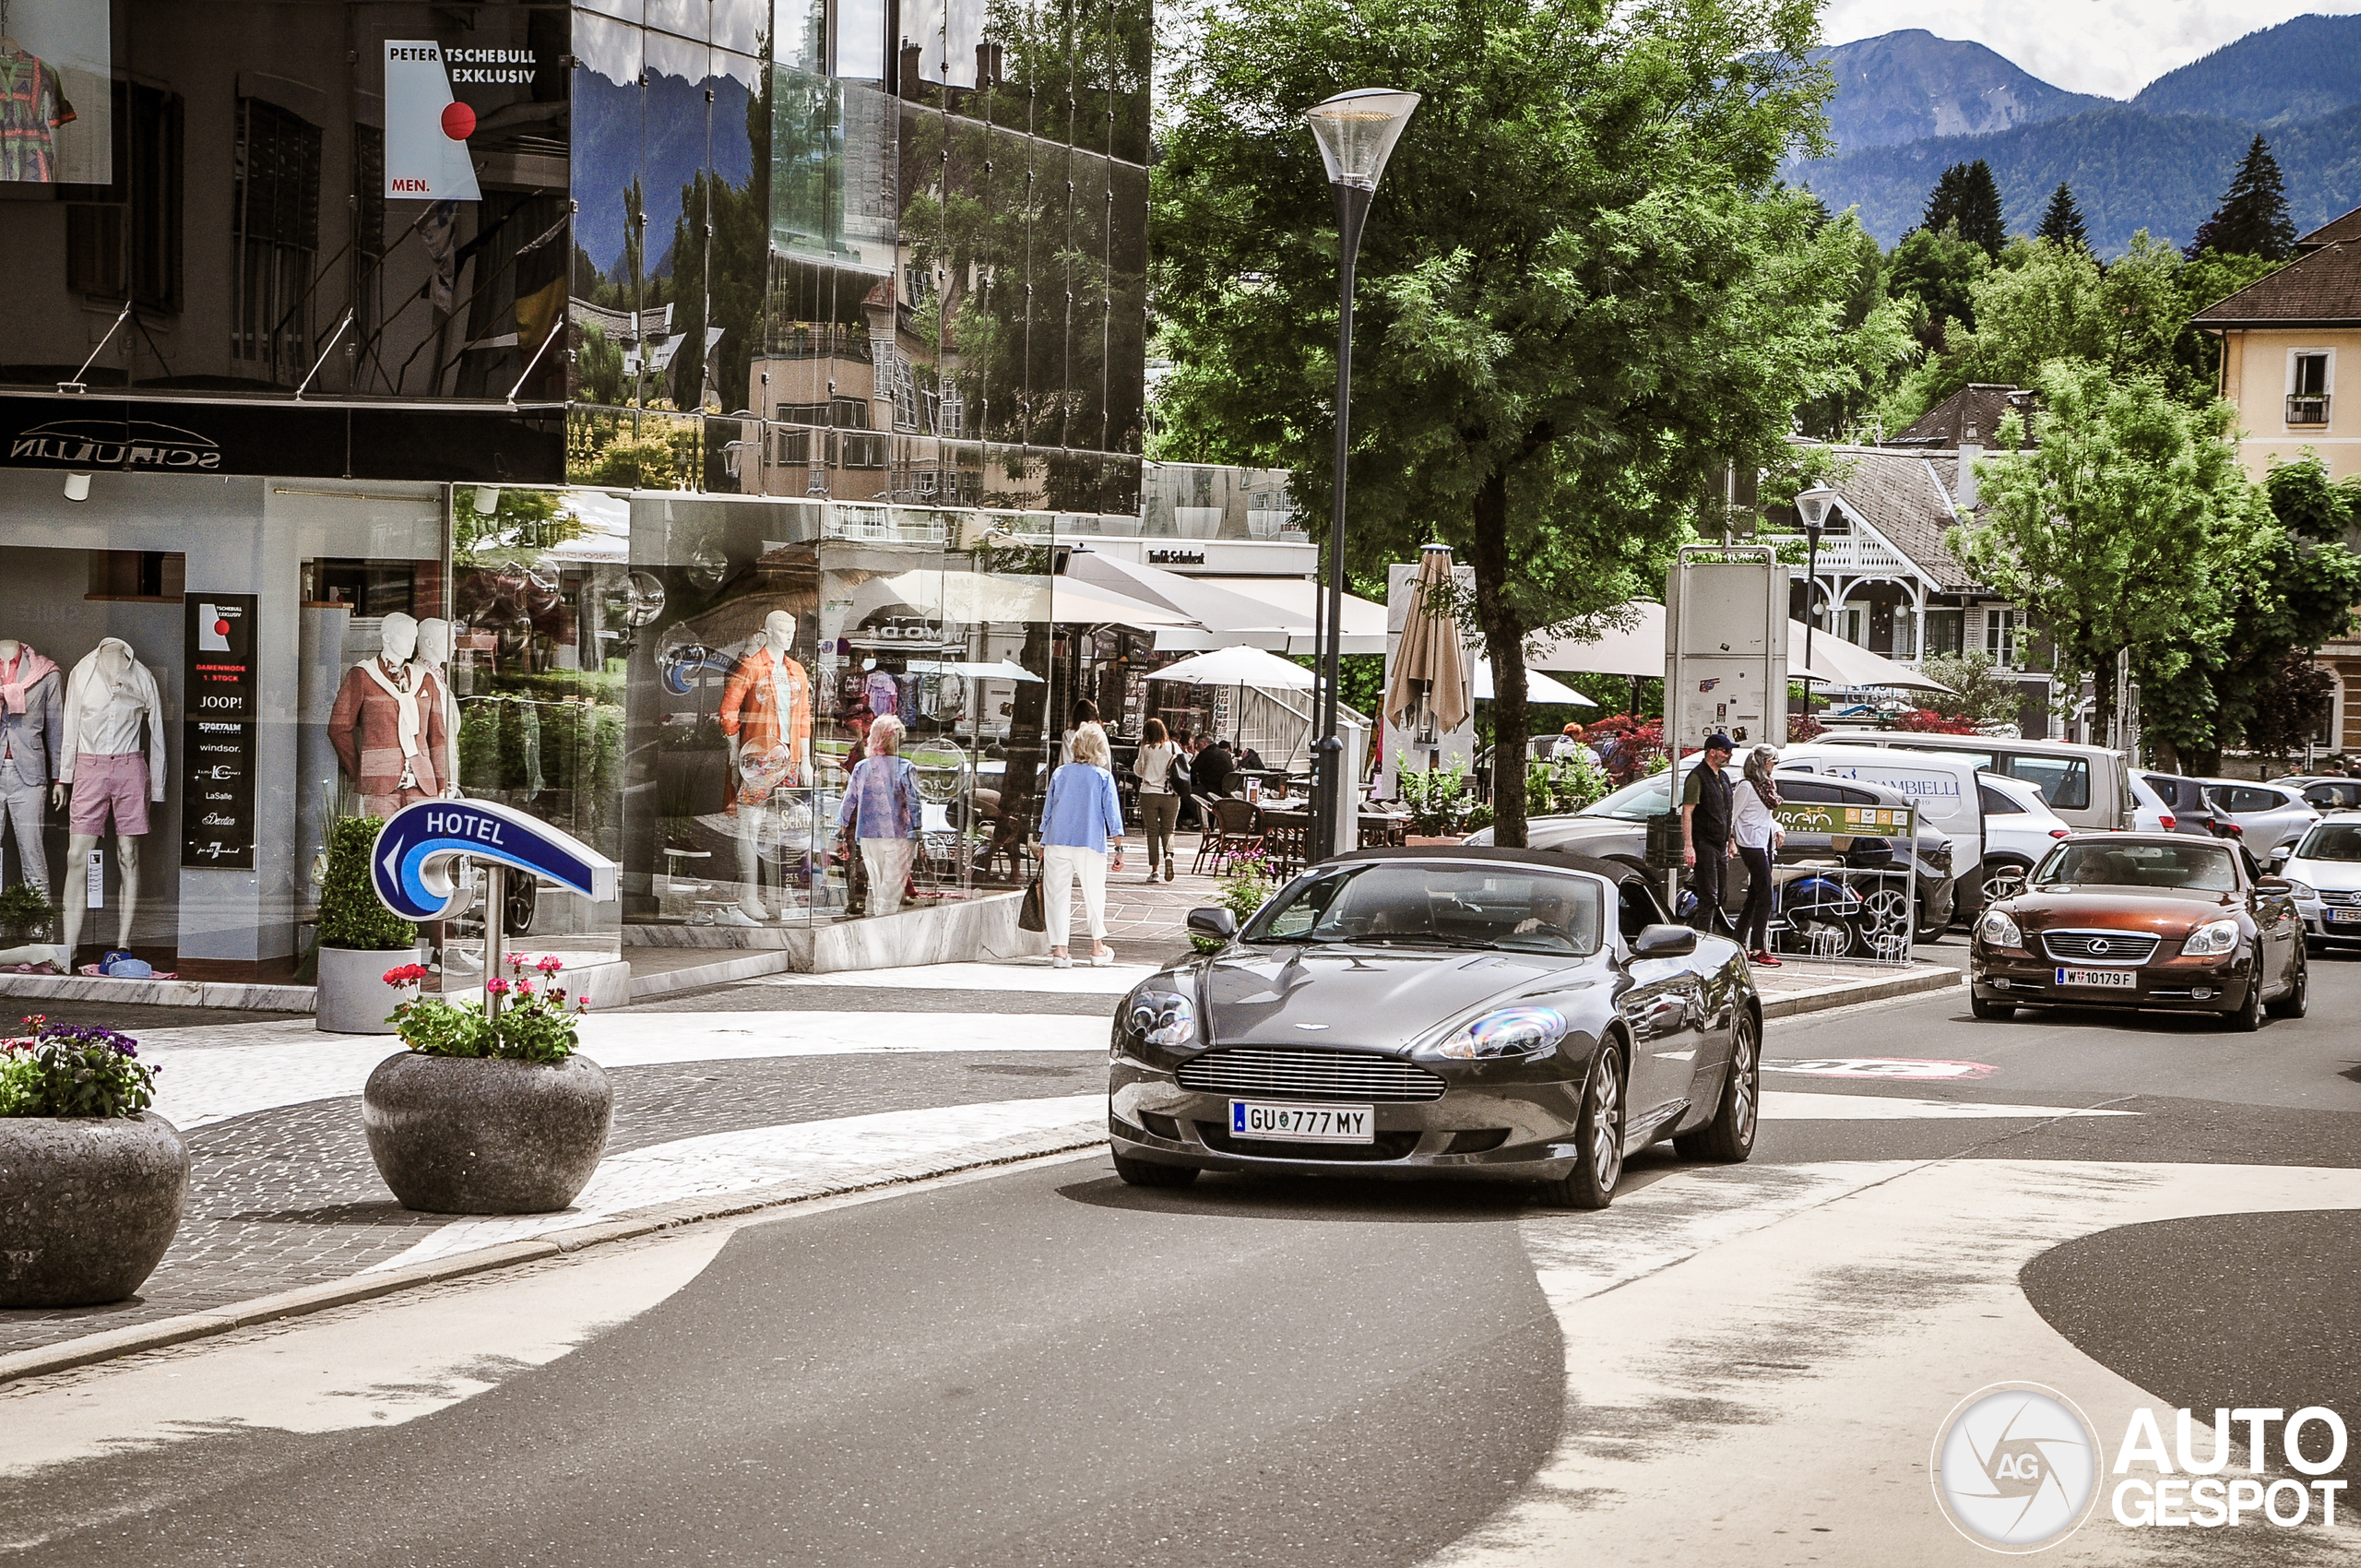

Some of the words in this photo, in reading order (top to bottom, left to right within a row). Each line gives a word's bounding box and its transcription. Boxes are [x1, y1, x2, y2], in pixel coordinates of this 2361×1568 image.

[389, 47, 438, 62] PETER
[445, 48, 536, 64] TSCHEBULL
[452, 68, 536, 84] EXKLUSIV
[391, 178, 431, 193] MEN.
[196, 664, 246, 672] DAMENMODE
[199, 695, 243, 709] JOOP!
[199, 743, 241, 753] windsor.
[205, 791, 233, 801] LaSalle
[426, 812, 504, 845] HOTEL
[2068, 971, 2077, 983] W
[2085, 972, 2120, 985] 10179
[2123, 974, 2130, 985] F
[1251, 1109, 1275, 1131] GU
[1292, 1111, 1332, 1133] 777
[1336, 1112, 1365, 1134] MY
